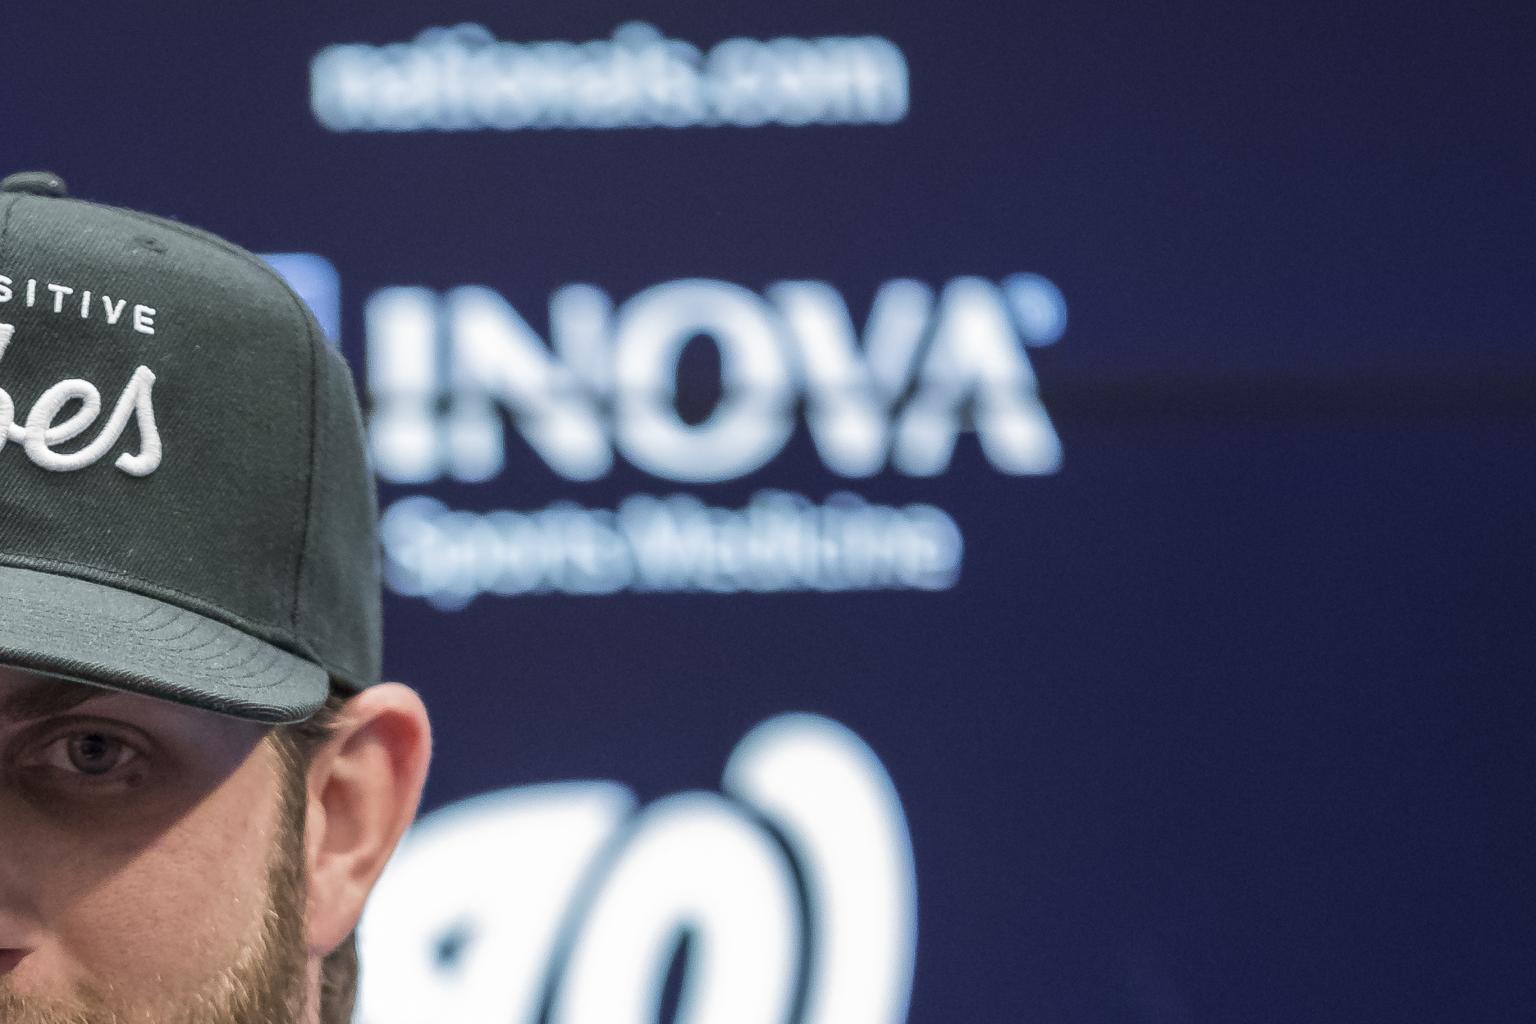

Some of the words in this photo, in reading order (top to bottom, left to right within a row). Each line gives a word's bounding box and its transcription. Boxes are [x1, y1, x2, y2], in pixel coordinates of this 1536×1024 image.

[311, 21, 910, 131] nationals.com
[365, 278, 1063, 484] INOVA
[378, 496, 631, 611] Sports
[615, 490, 964, 592] Medicine
